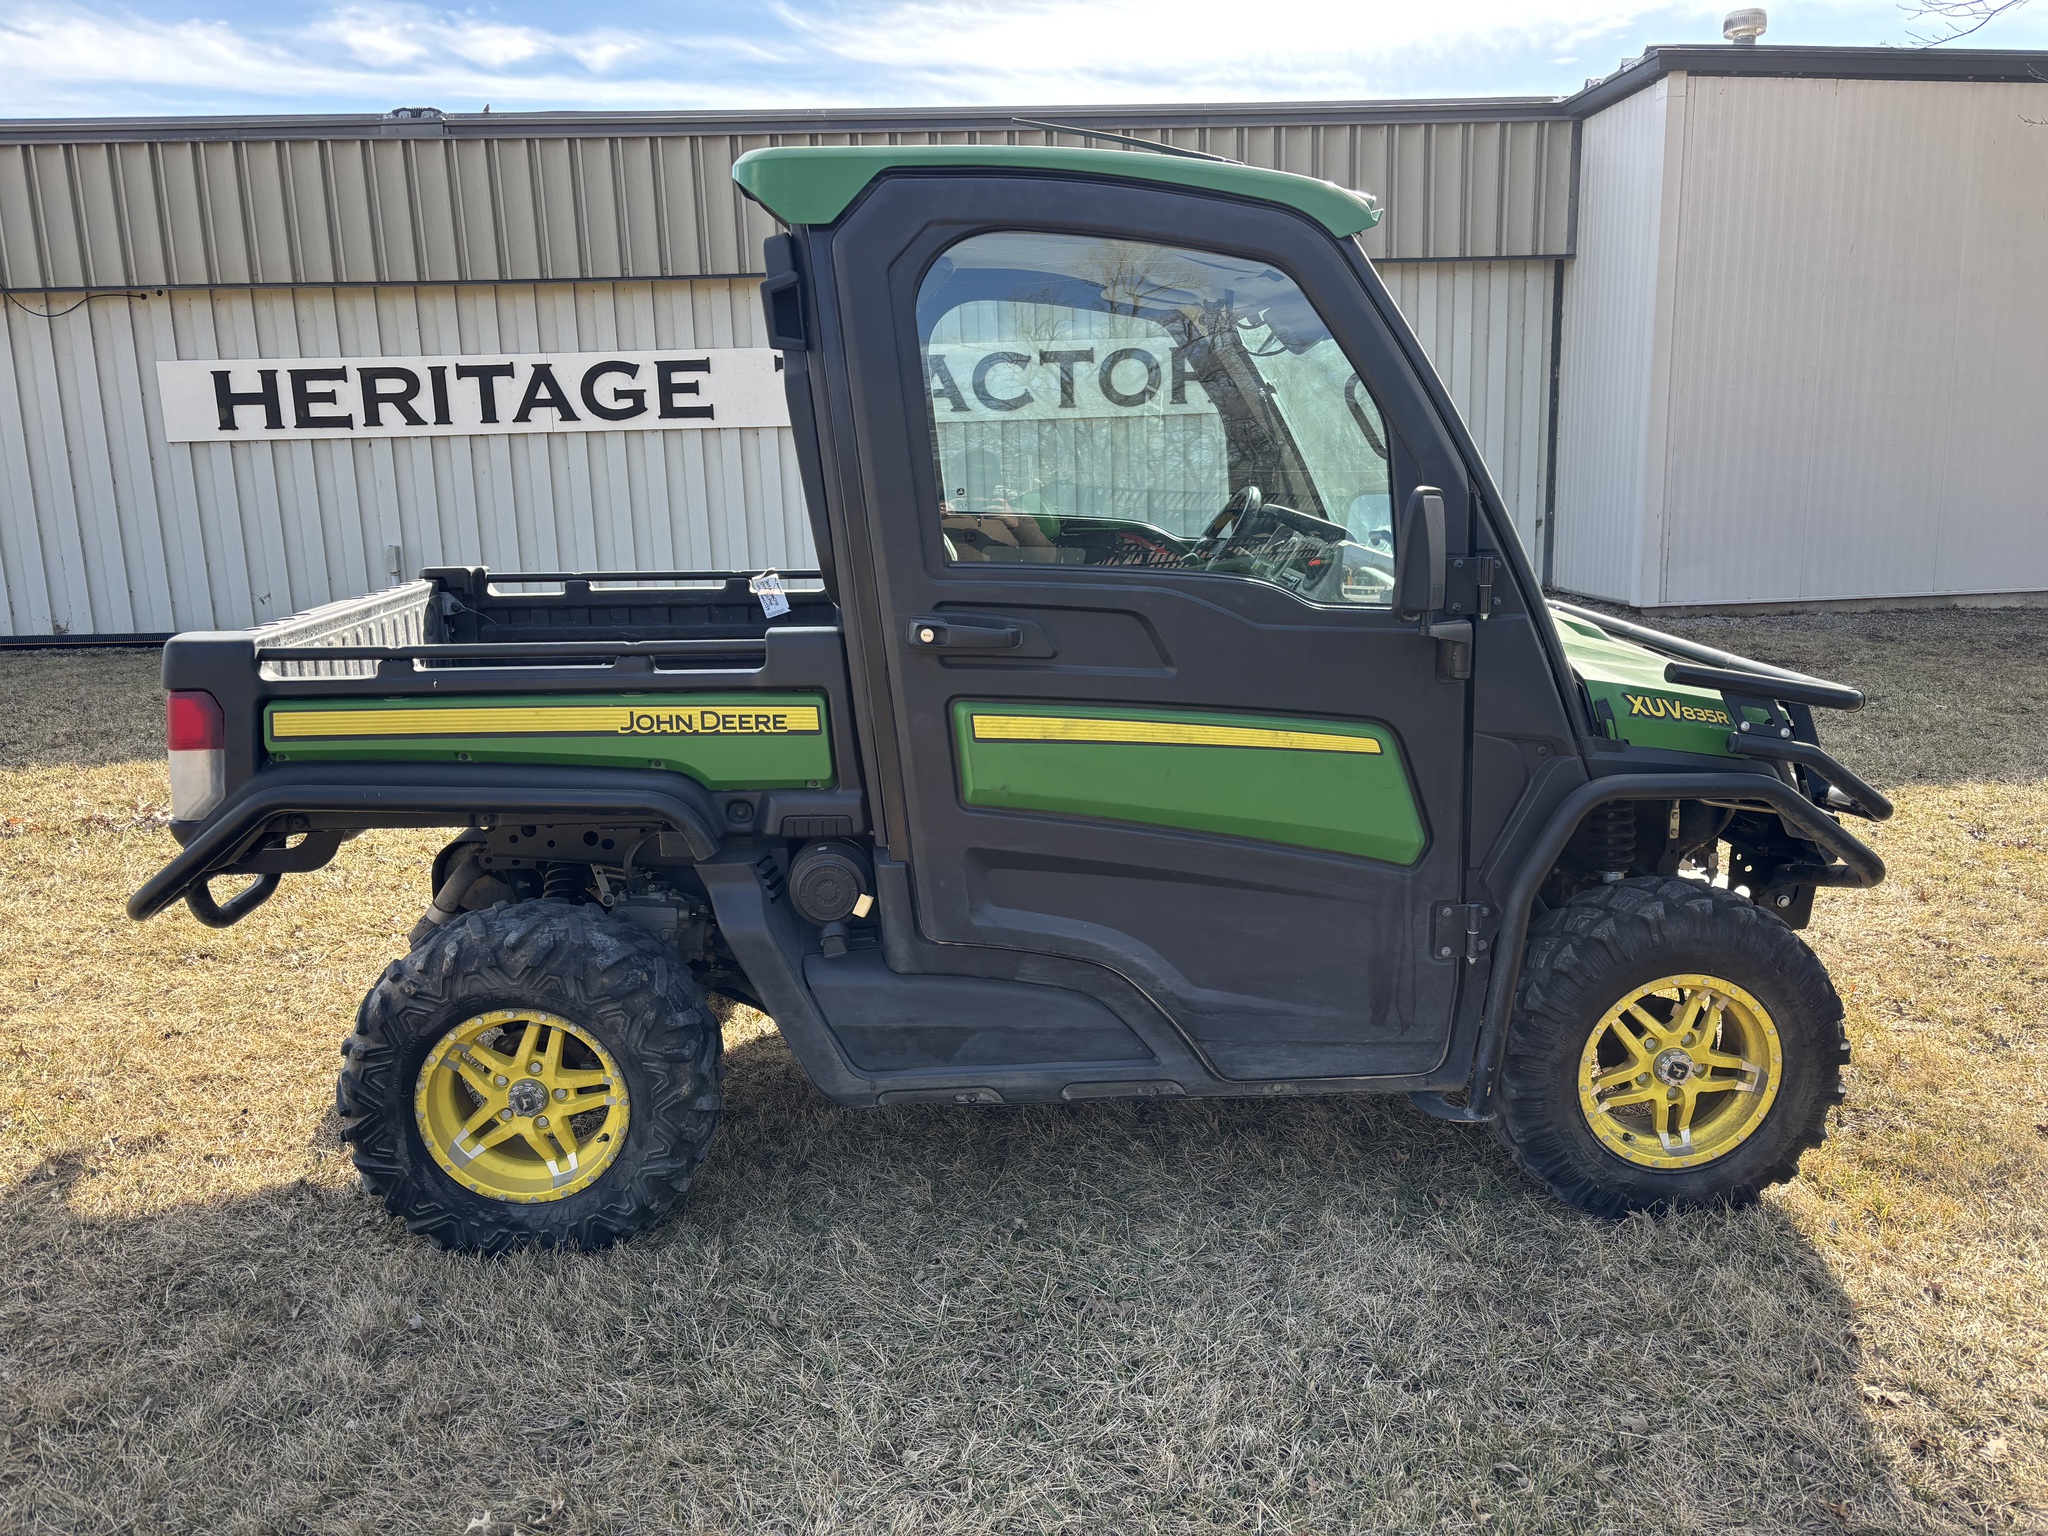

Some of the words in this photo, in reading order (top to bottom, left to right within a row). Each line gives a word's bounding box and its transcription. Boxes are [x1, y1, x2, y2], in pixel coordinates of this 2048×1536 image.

[210, 356, 715, 431] HERITAGE
[620, 710, 694, 731] JOHN
[700, 710, 788, 731] DEERE
[1623, 693, 1732, 726] XUV835R
